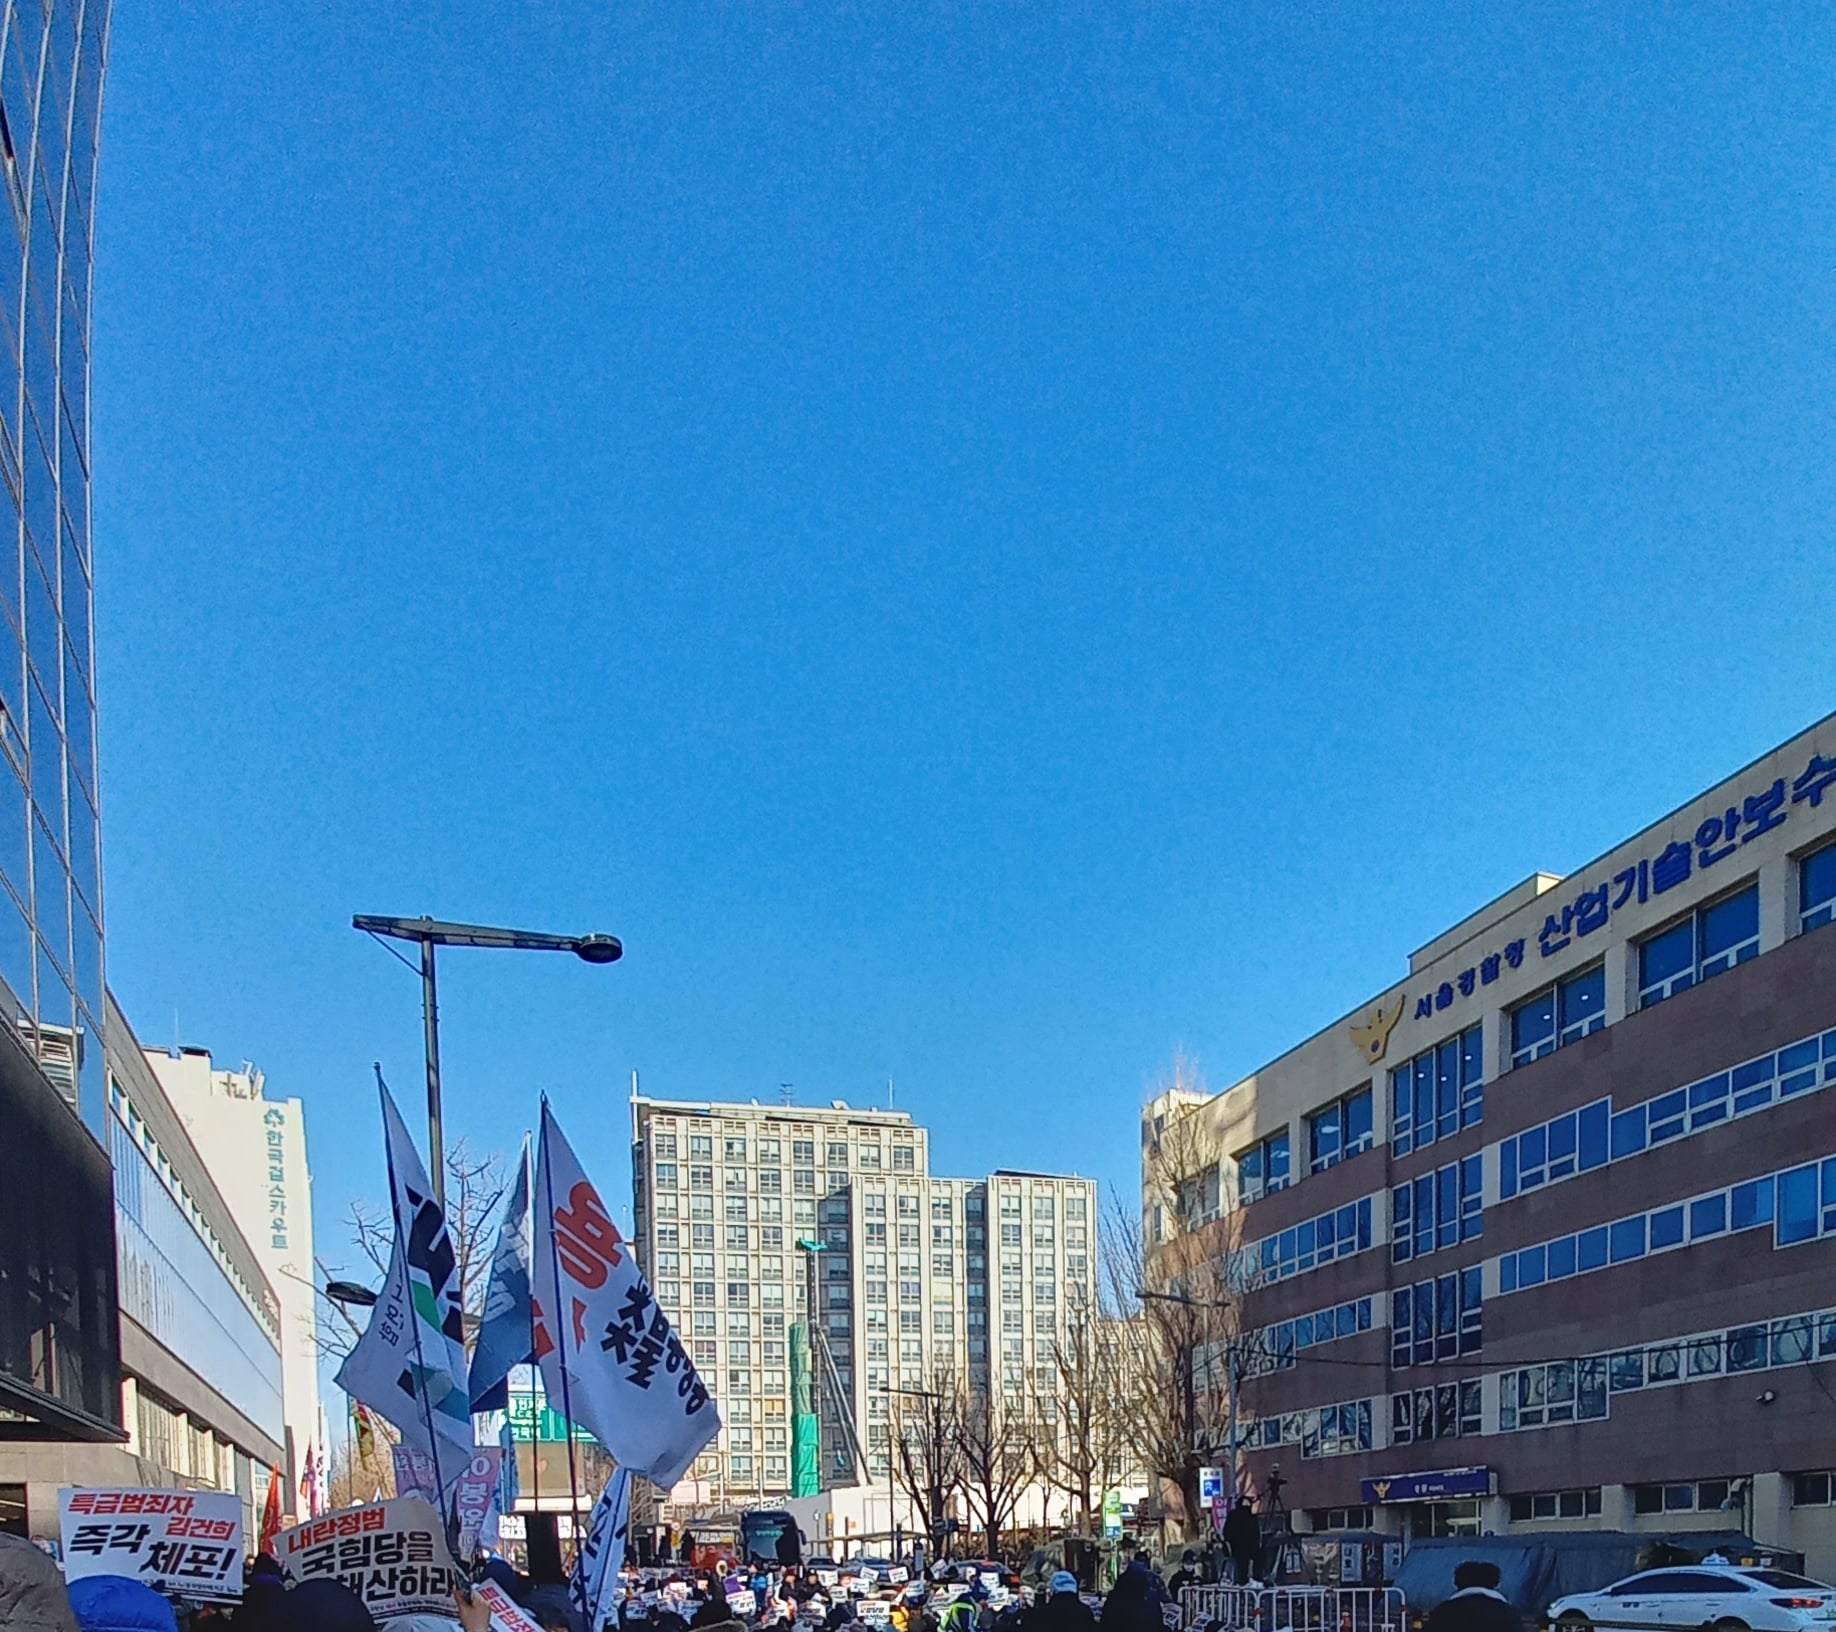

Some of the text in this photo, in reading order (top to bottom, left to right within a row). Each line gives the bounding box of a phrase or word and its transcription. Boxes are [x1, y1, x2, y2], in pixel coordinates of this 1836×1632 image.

[1413, 937, 1526, 1020] 서울경찰청
[266, 1129, 288, 1250] 한국걸스카우트
[67, 1492, 194, 1517] 특급범죄자
[69, 1522, 151, 1556] 즉각
[164, 1516, 237, 1542] 김건희
[286, 1506, 386, 1553] 내란정범
[138, 1539, 238, 1582] 체포!
[300, 1529, 435, 1576] 국힘당을
